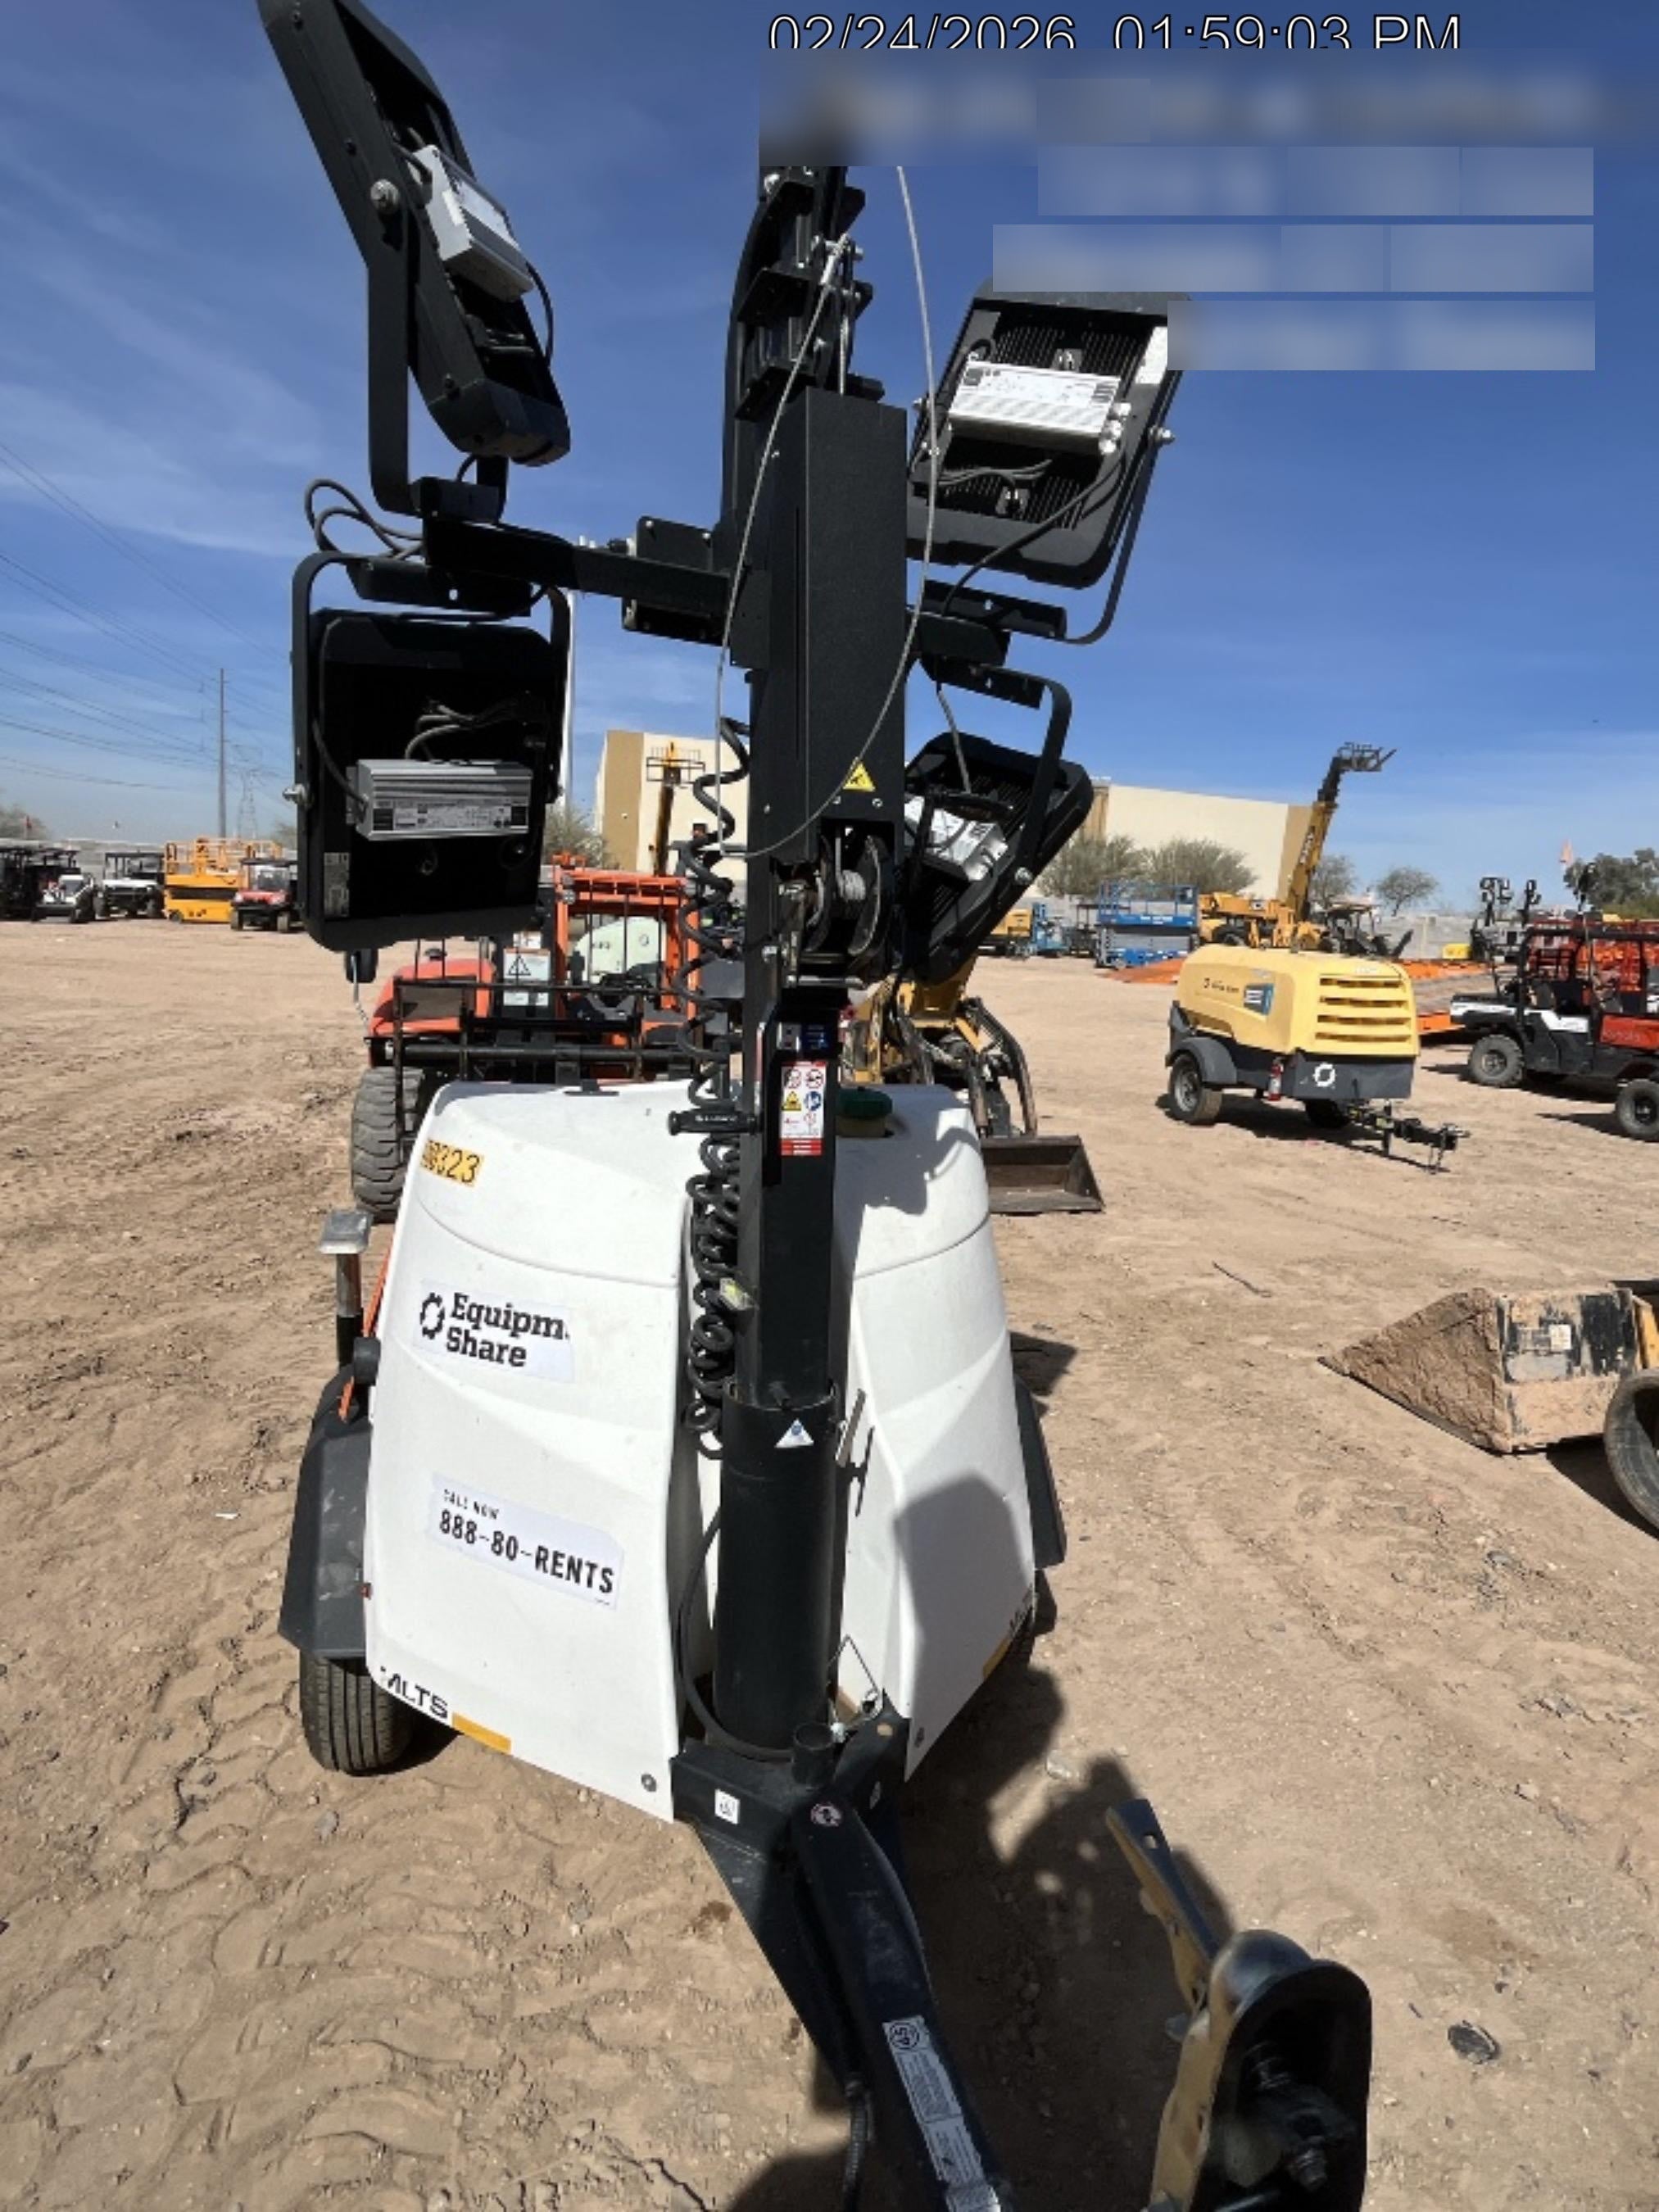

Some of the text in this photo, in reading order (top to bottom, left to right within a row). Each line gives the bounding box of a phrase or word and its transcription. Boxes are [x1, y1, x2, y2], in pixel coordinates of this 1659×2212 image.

[450, 1291, 570, 1341] Equipm
[446, 1326, 527, 1367] Share
[438, 1508, 614, 1594] 888-80-RENTS
